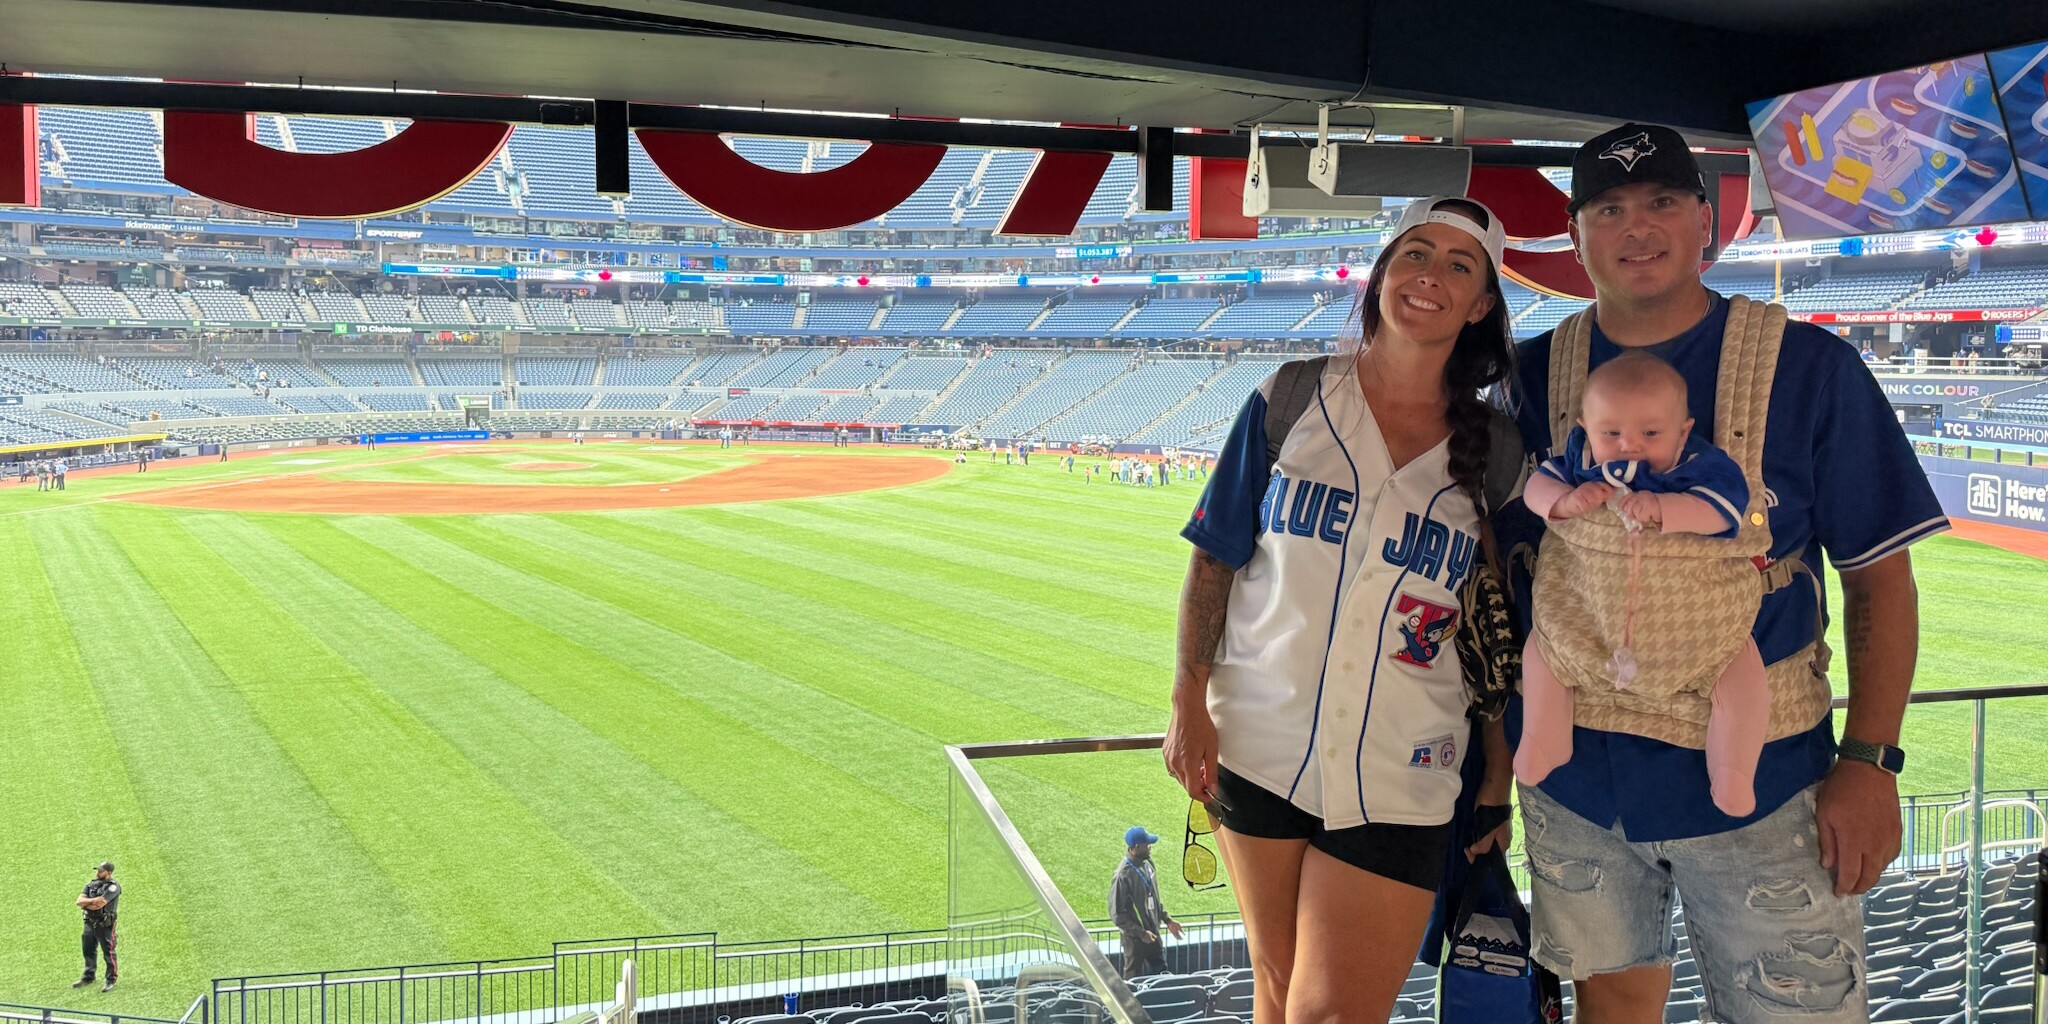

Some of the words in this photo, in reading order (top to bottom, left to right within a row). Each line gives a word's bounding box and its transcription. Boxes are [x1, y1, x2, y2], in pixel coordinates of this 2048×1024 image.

[125, 221, 172, 230] ticketmaster
[366, 229, 423, 239] SPORTSNET
[1741, 249, 1771, 257] TORONTO
[1779, 247, 1793, 255] BLUE
[1794, 246, 1809, 254] JAYS
[1835, 313, 1860, 322] Proud
[1861, 314, 1888, 322] owner
[1889, 312, 1898, 321] of
[1899, 311, 1912, 321] the
[1913, 311, 1932, 321] Blue
[1933, 311, 1953, 322] Jays
[1991, 310, 2023, 319] ROGERS
[368, 325, 412, 333] Clubhouse
[1881, 384, 1909, 395] INK
[1912, 384, 1979, 397] COLOUR
[1944, 422, 1973, 437] TCL
[1259, 470, 1355, 545] BLUE
[2005, 498, 2046, 522] How.
[1382, 511, 1479, 592] JAY
